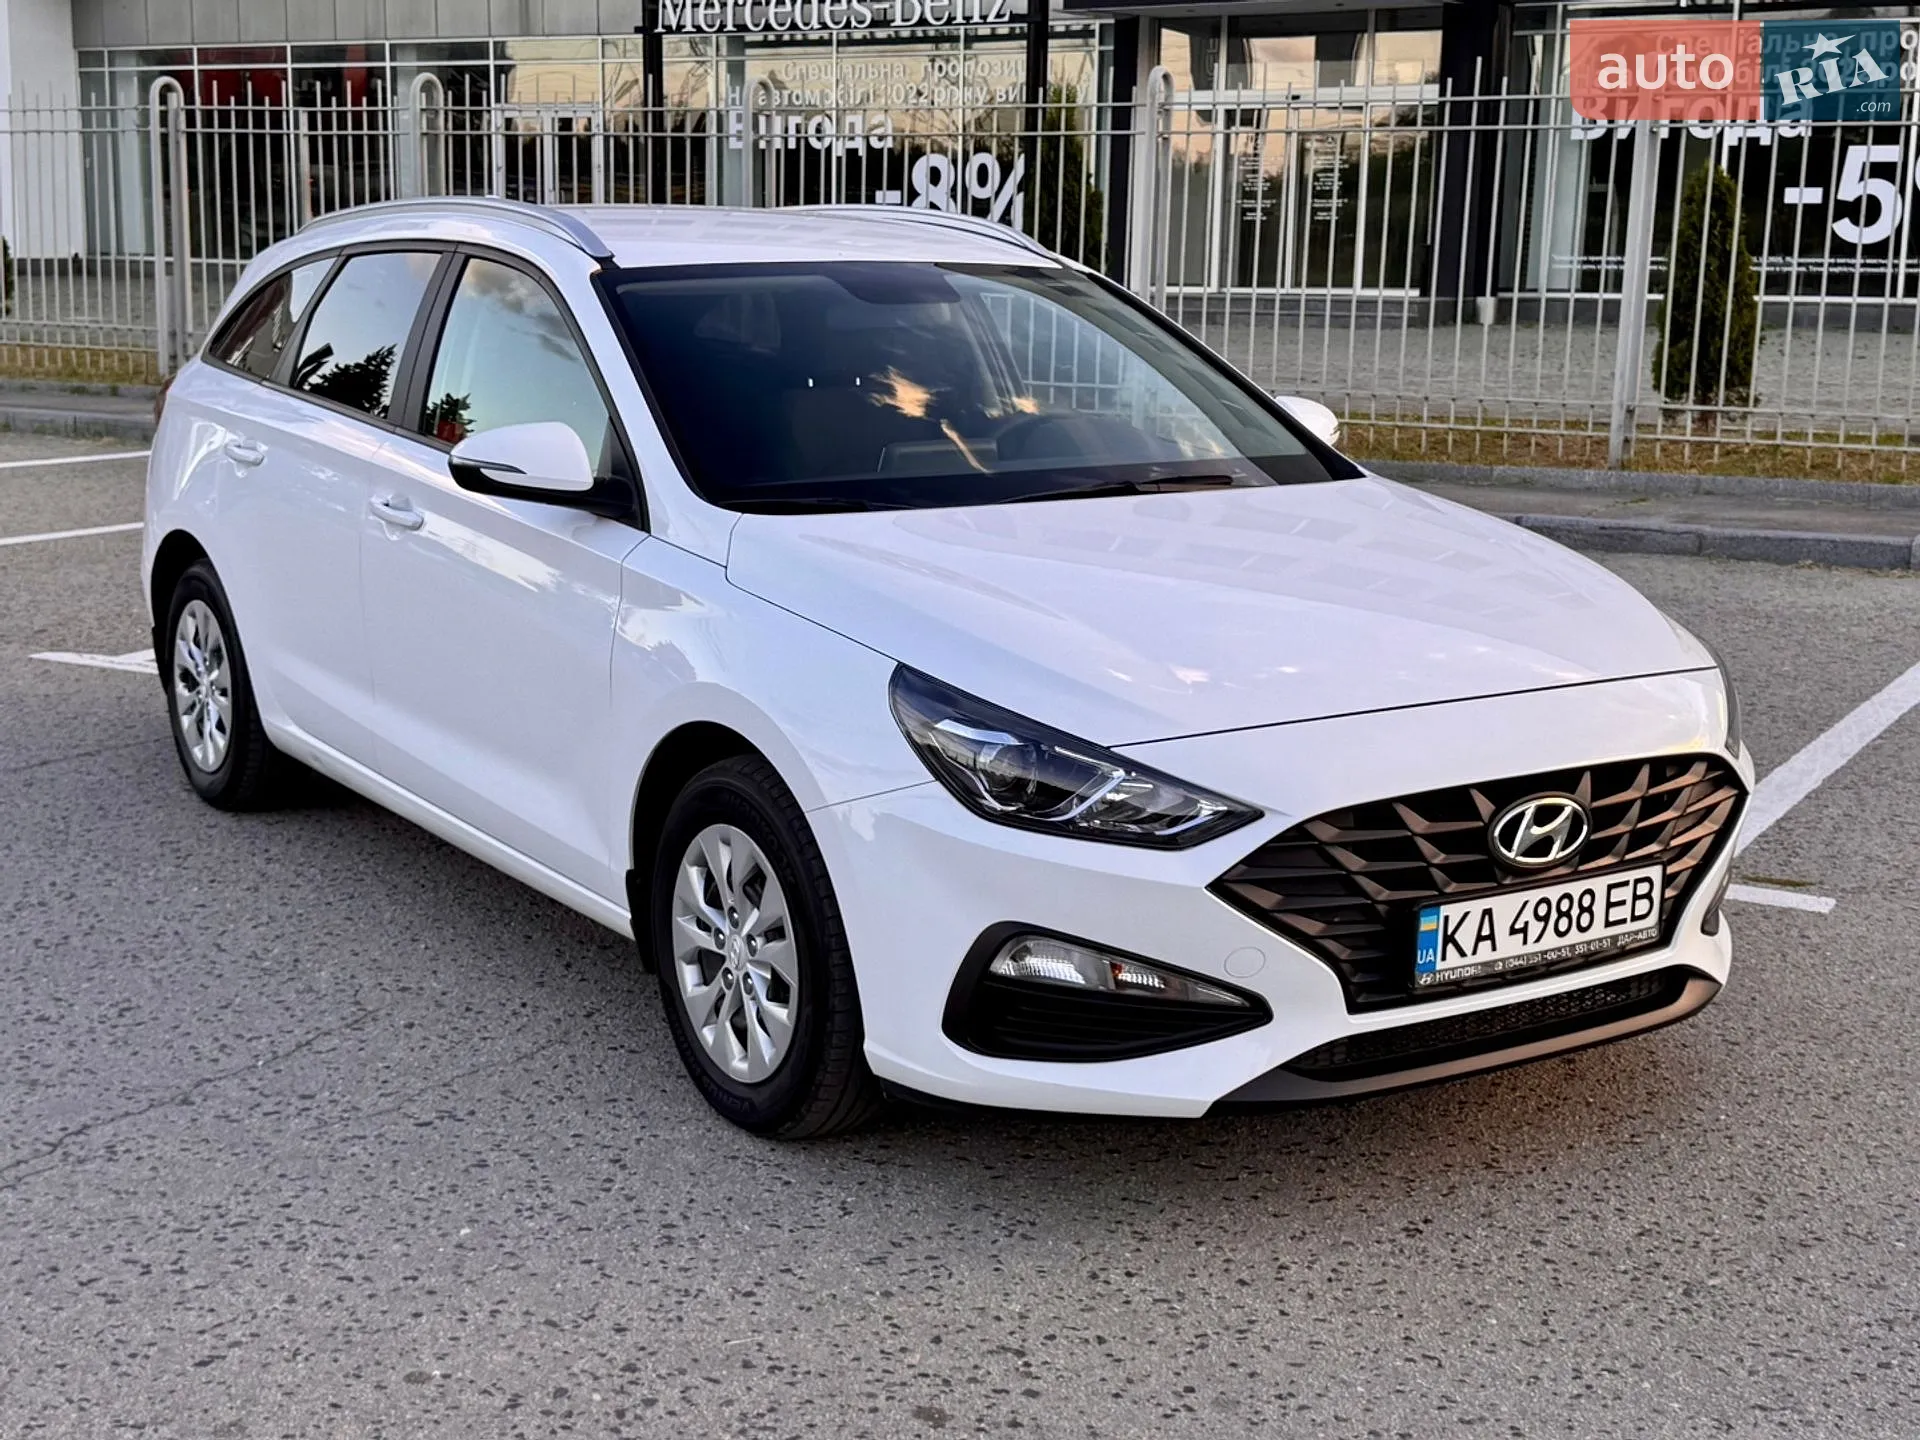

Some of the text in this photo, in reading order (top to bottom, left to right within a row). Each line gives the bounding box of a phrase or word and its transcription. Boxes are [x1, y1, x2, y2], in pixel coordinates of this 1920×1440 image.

[1441, 876, 1655, 962] KA 4988 EB
[1417, 948, 1435, 964] UA
